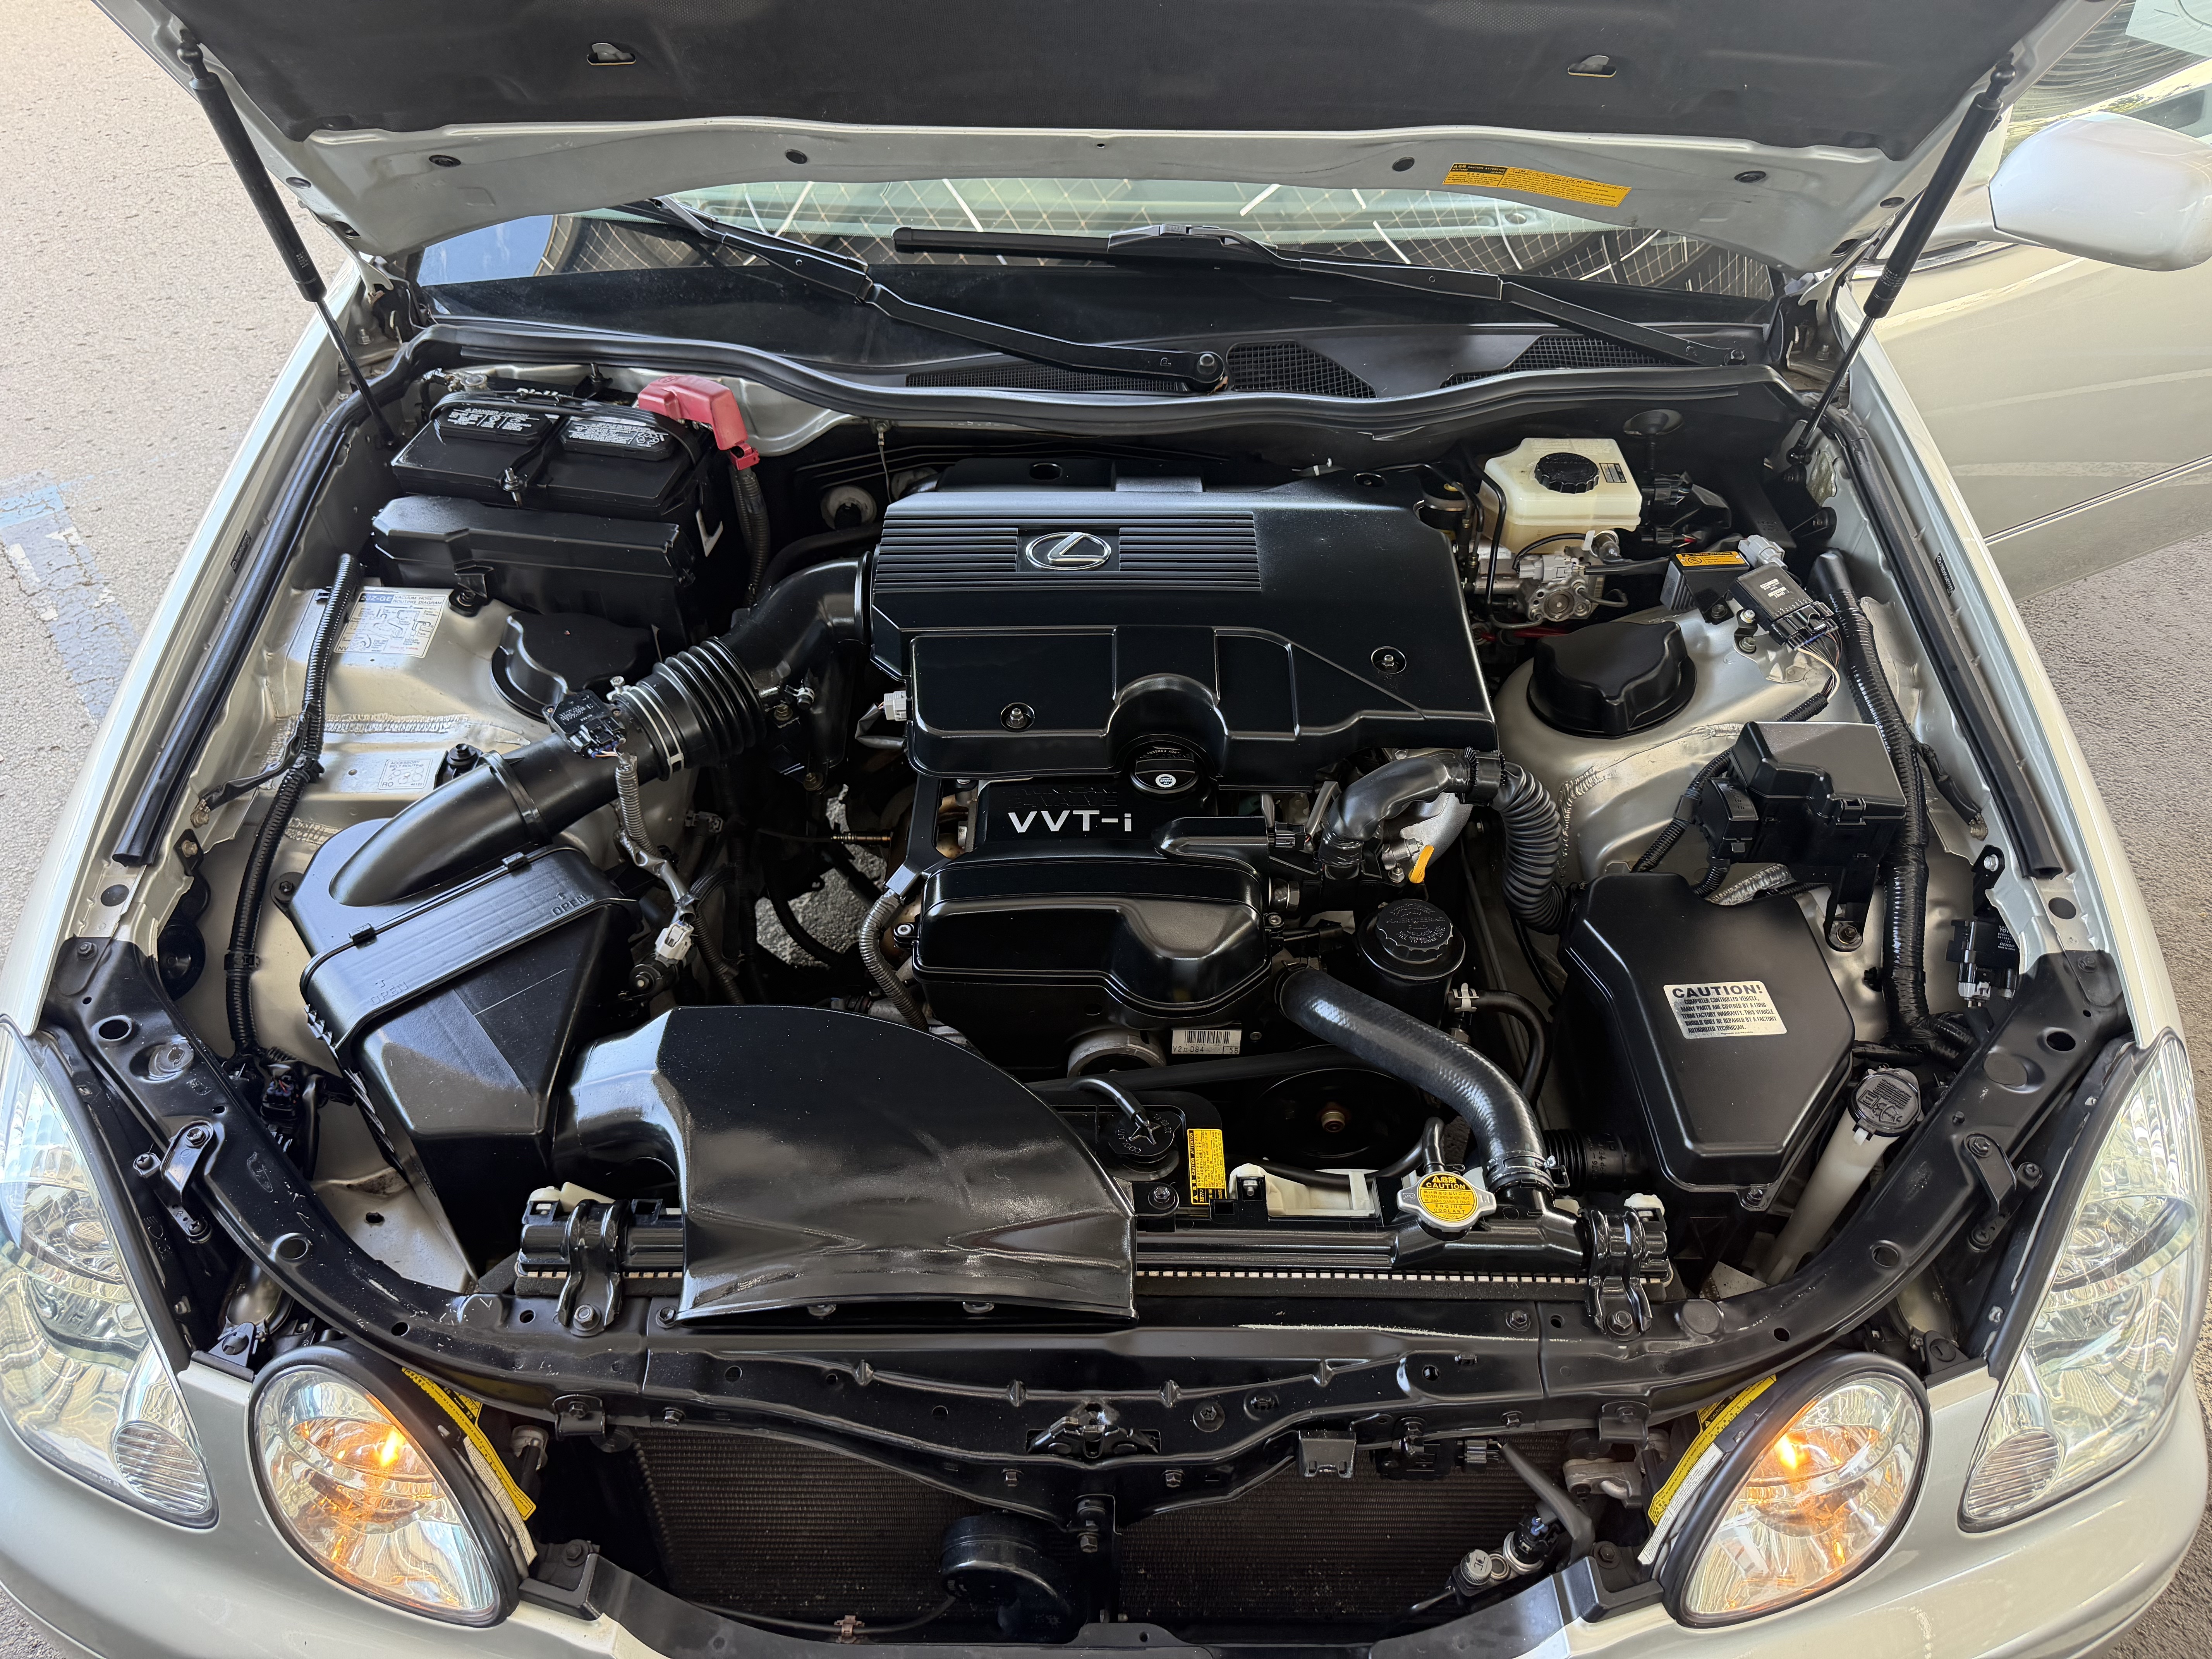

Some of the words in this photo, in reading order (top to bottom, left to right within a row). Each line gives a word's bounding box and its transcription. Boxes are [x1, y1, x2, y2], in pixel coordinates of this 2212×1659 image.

[1008, 810, 1132, 833] VVT-i
[551, 895, 588, 916] OPEN
[371, 981, 409, 1005] OPEN
[1672, 984, 1763, 998] CAUTION!
[1710, 1403, 1725, 1420] CAUTION
